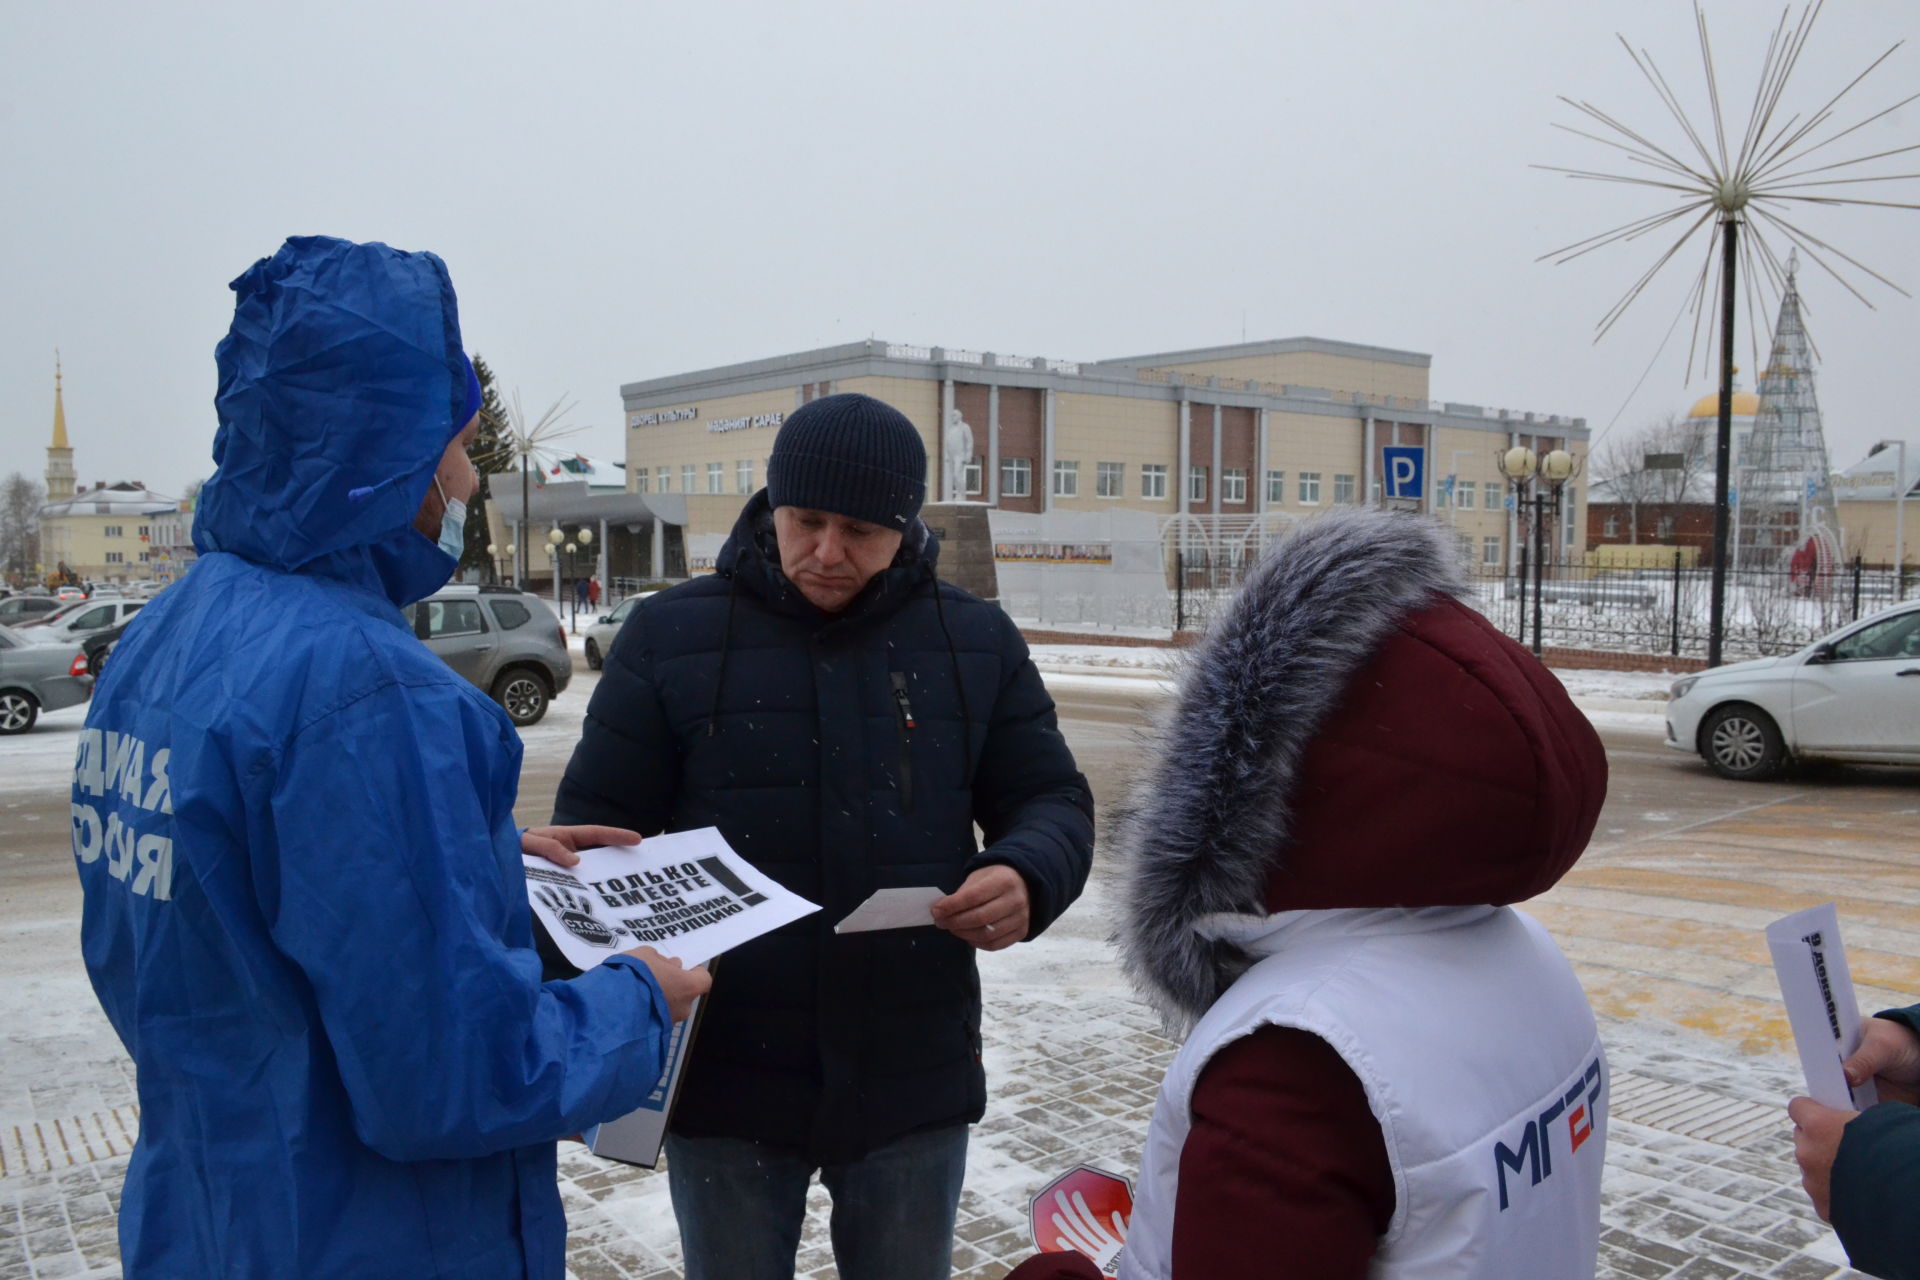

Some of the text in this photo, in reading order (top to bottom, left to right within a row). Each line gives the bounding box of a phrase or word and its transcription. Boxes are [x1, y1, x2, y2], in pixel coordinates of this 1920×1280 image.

[659, 407, 698, 423] КУЛЬТУРЫ
[753, 412, 783, 428] САРАЕ
[1392, 456, 1415, 497] P
[589, 862, 699, 895] ТОЛЬКО
[601, 876, 711, 908] ВМЕСТЕ
[648, 896, 687, 914] МЫ
[564, 918, 606, 933] СТОП
[631, 903, 744, 942] КОРРУПЦИЮ
